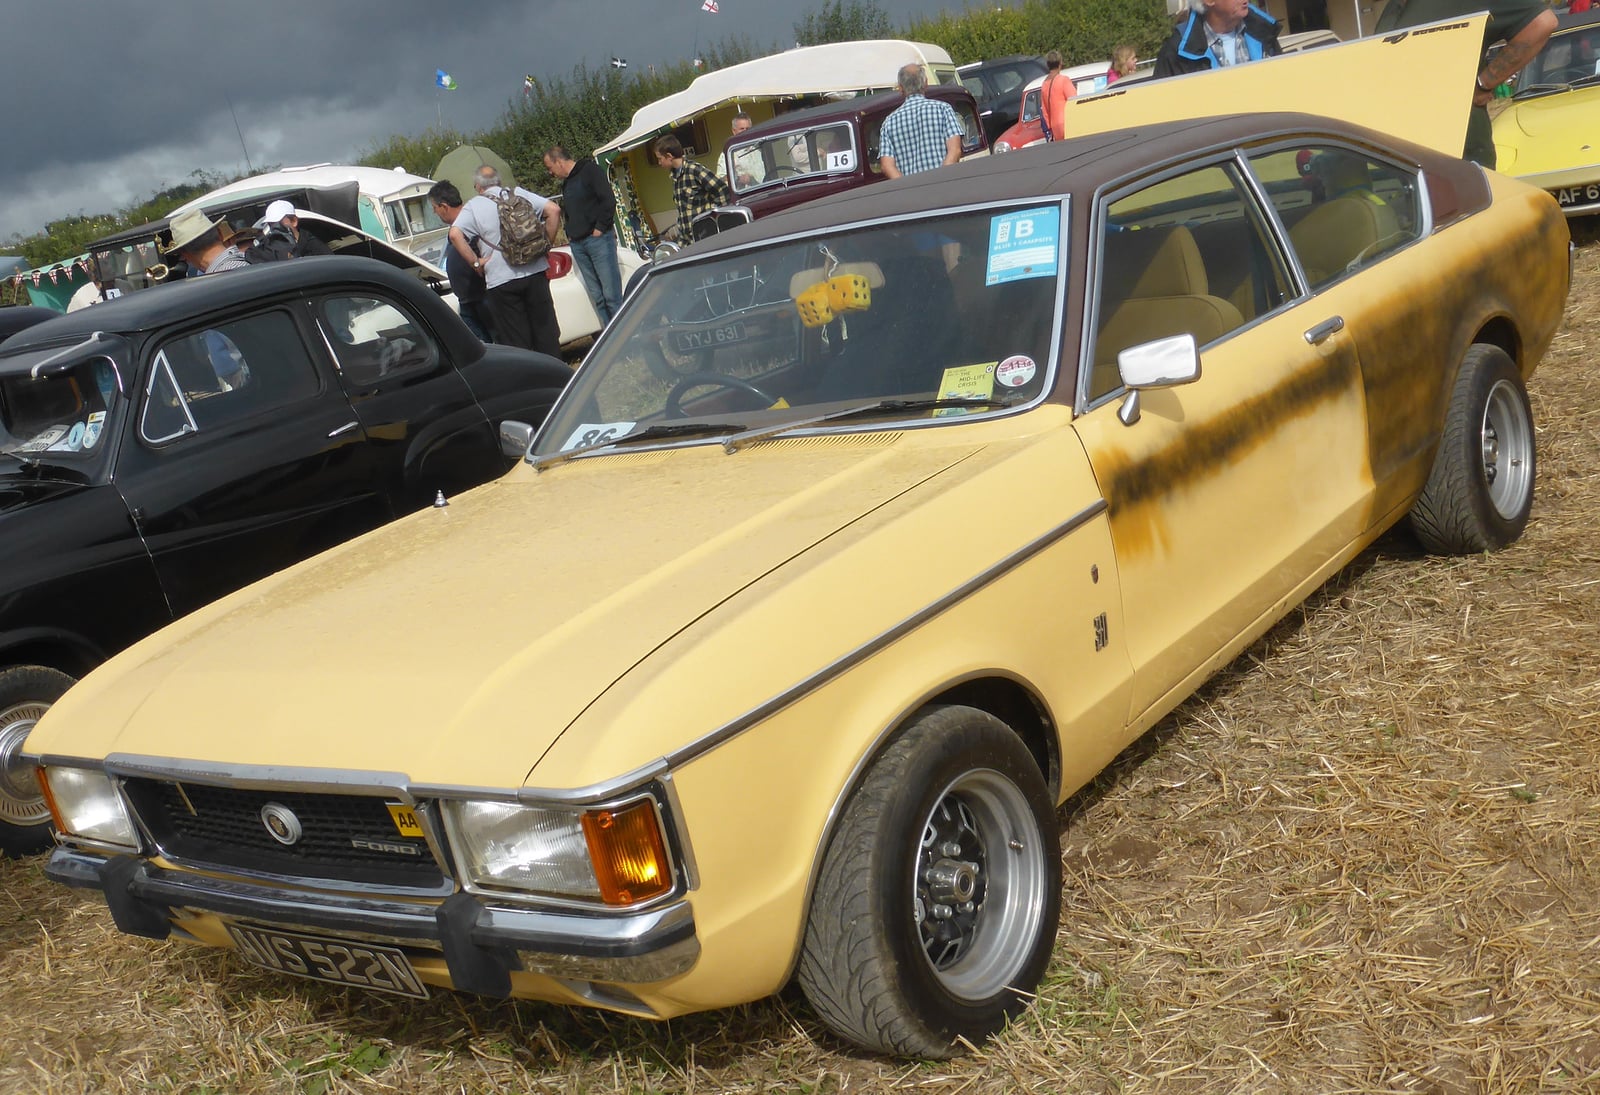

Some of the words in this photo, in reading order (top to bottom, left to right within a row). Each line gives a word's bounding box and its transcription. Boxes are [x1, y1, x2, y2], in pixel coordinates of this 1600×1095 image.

[833, 154, 849, 167] 16
[1550, 187, 1582, 204] AF
[1586, 184, 1600, 200] 6
[1015, 219, 1034, 239] B
[684, 330, 712, 347] YYJ
[715, 325, 739, 342] 631
[959, 374, 986, 382] MID-LIFE
[574, 428, 617, 449] 86
[398, 812, 419, 828] AA
[351, 840, 417, 855] FORD
[230, 926, 309, 974] AVS
[300, 941, 423, 995] 522N
